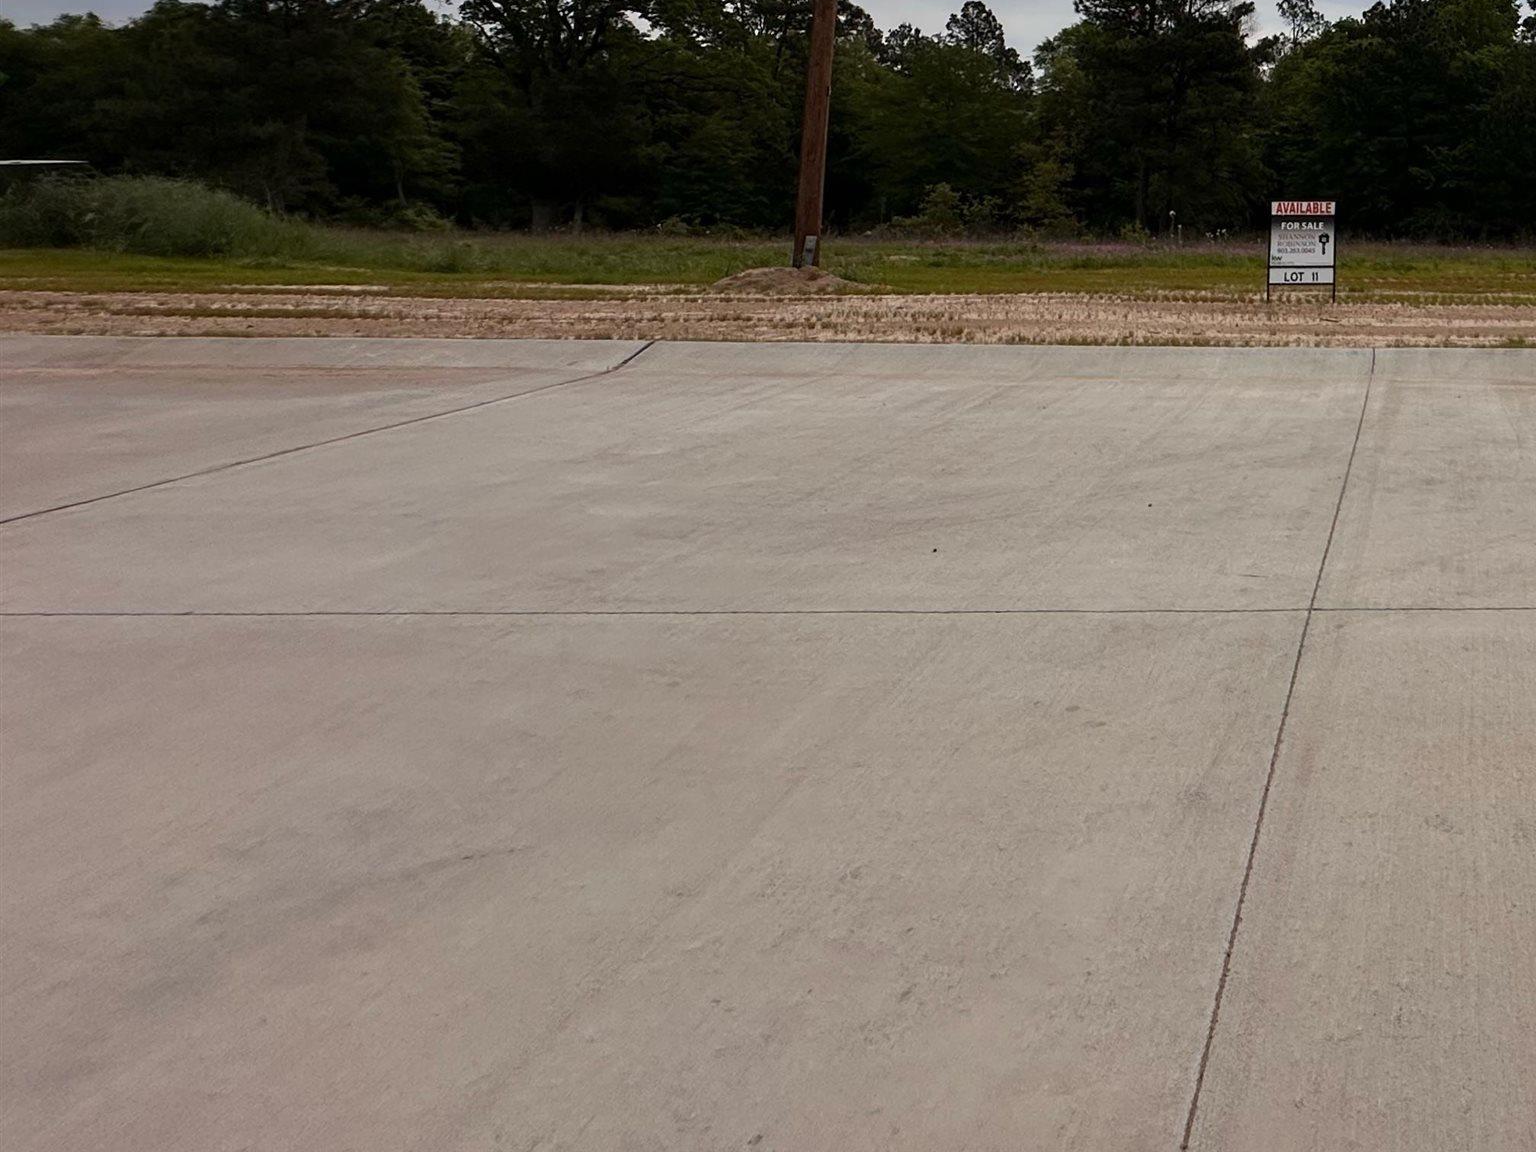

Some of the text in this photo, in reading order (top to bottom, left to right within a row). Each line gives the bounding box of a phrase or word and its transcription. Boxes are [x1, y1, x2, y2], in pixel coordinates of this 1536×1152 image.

[1276, 202, 1331, 214] AVAILABLE
[1281, 222, 1324, 230] FOR SALE
[1284, 272, 1319, 282] LOT 11
